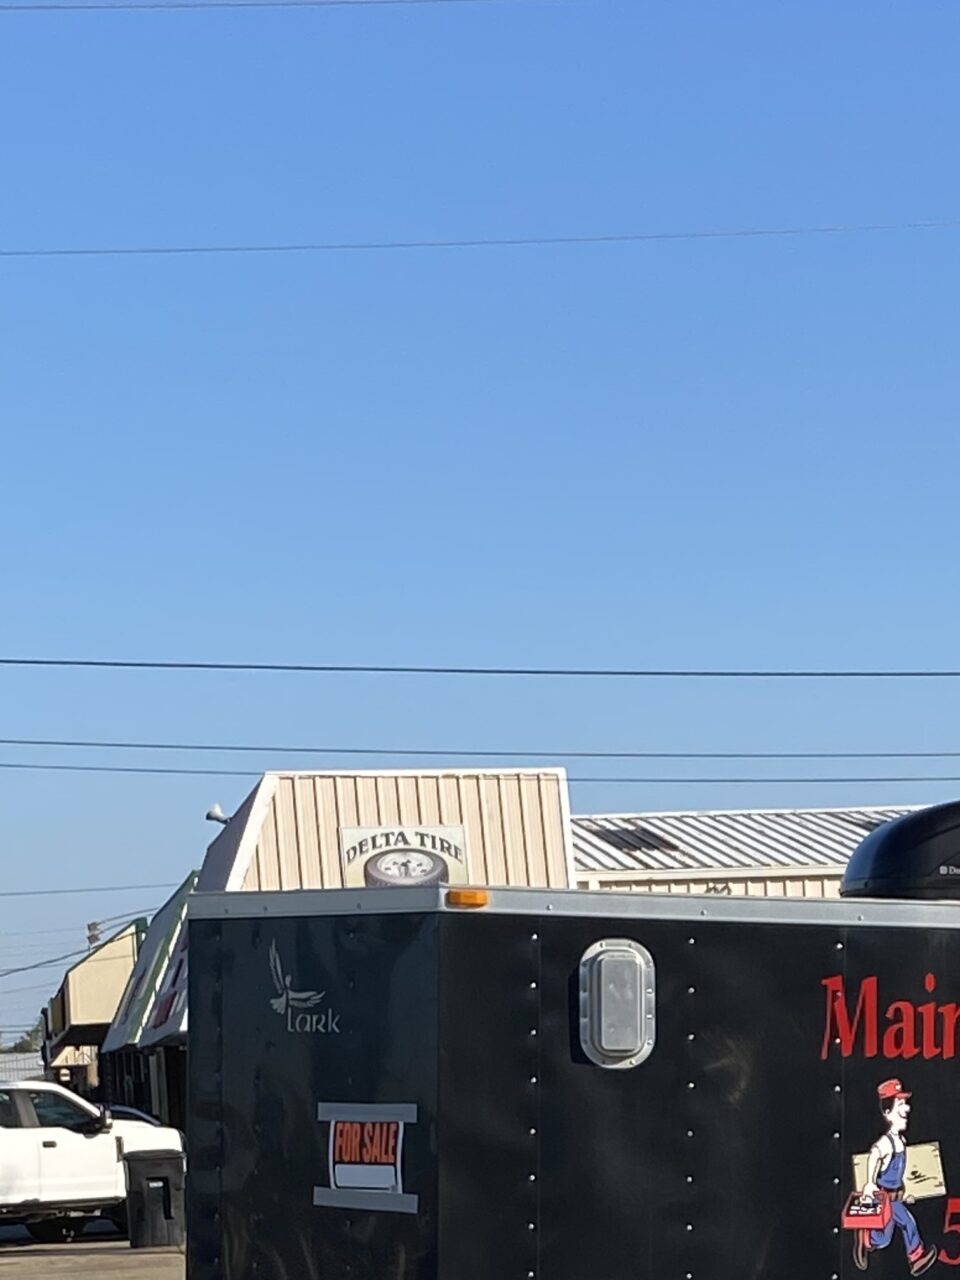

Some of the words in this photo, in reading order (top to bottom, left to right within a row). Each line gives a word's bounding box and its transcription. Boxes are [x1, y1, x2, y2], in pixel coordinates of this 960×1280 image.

[346, 831, 411, 866] DELTA
[414, 831, 464, 864] TIRE
[334, 1122, 361, 1162] FOR
[361, 1122, 398, 1164] SALE
